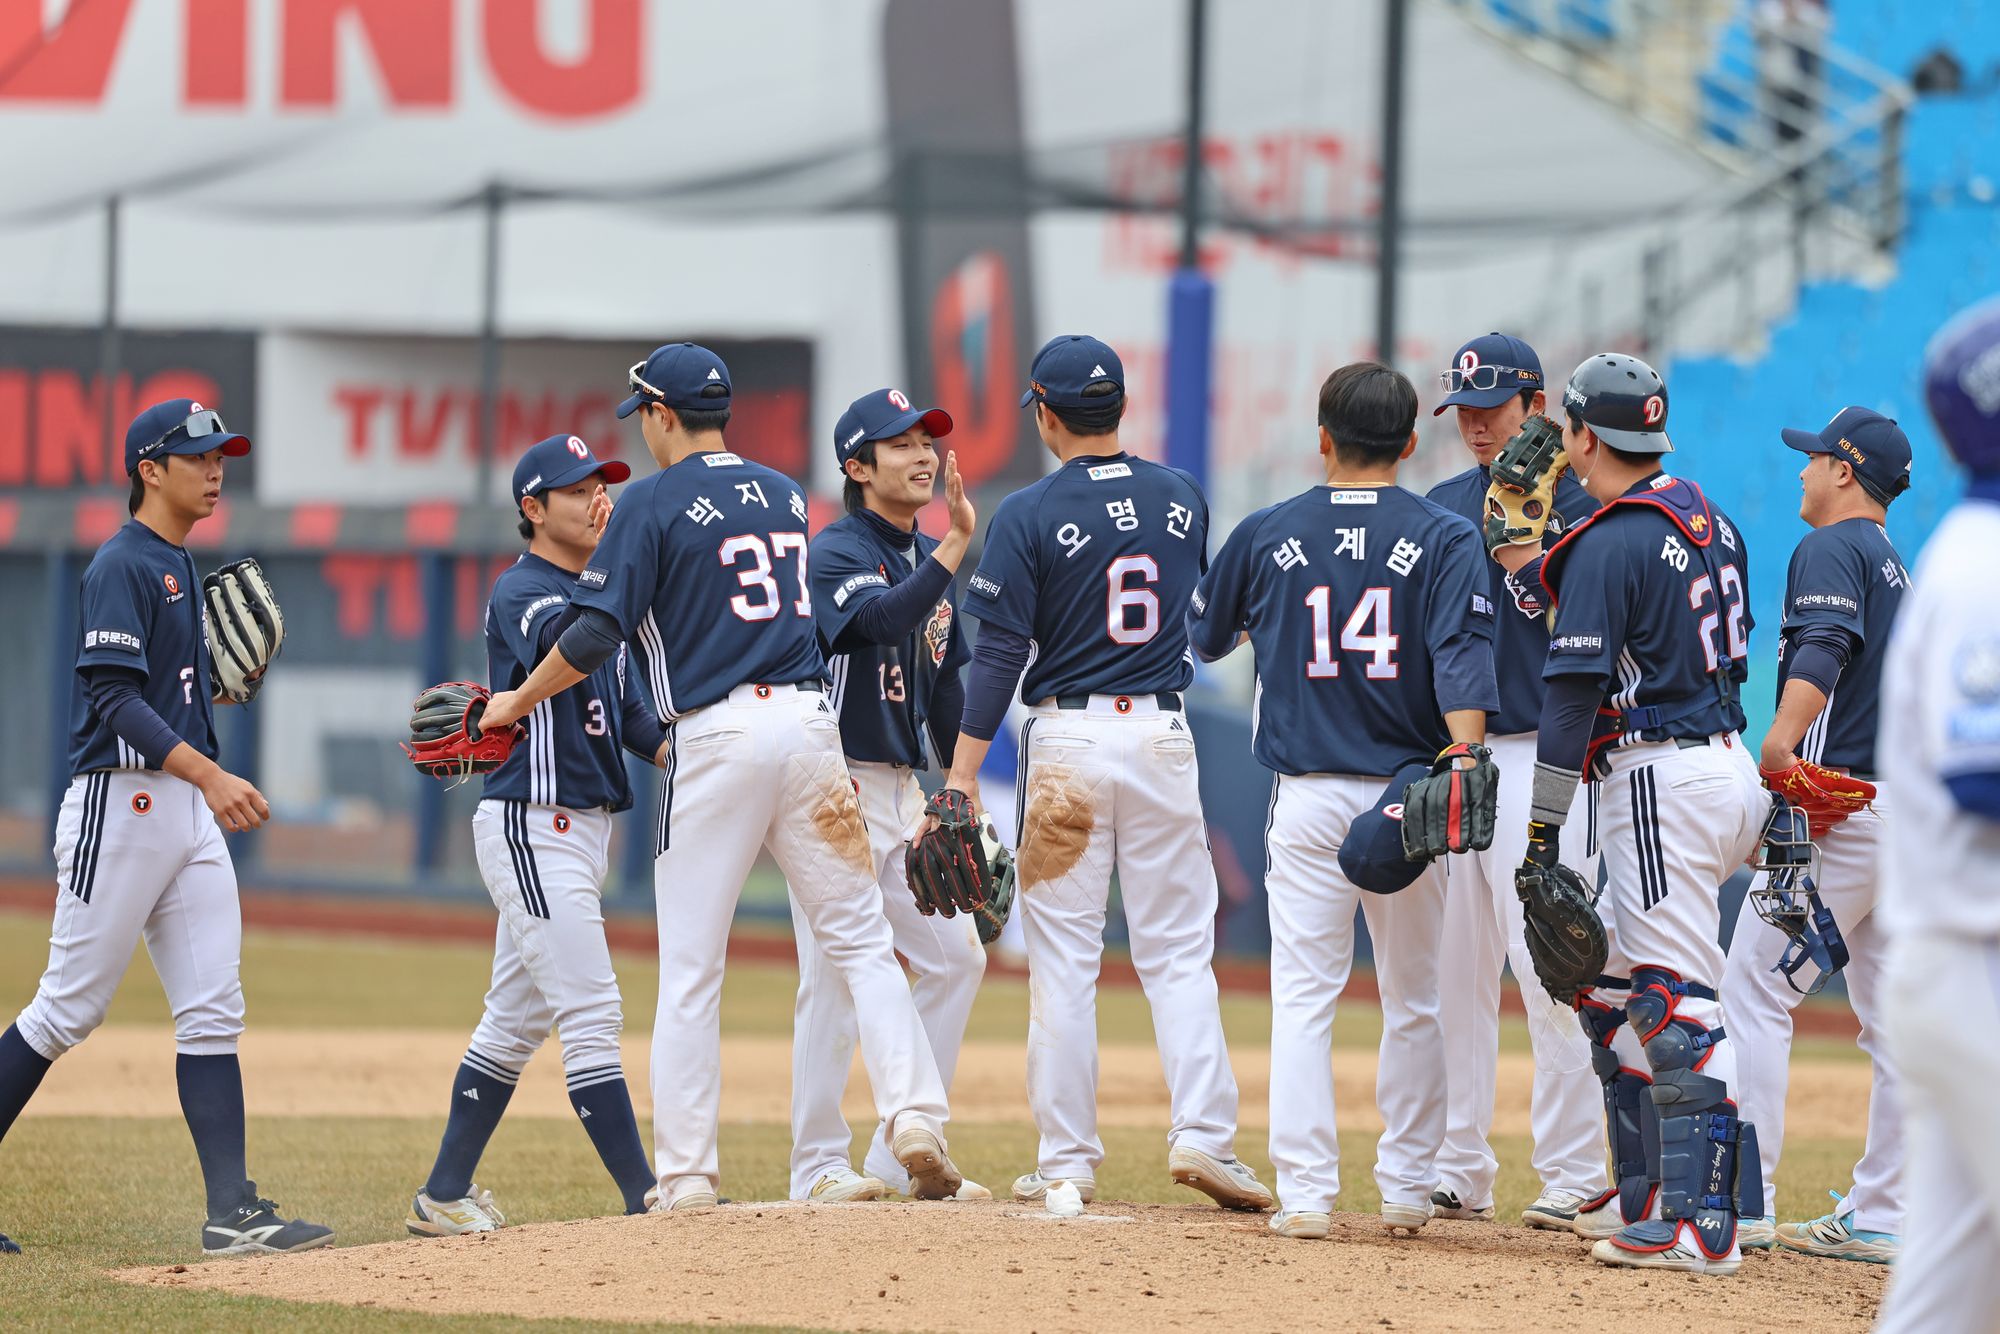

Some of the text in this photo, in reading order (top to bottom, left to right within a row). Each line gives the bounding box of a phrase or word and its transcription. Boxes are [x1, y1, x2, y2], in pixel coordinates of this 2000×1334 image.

[1838, 437, 1866, 465] KB Pay
[717, 532, 812, 623] 37
[1107, 553, 1161, 646] 6
[1687, 563, 1748, 673] 22
[98, 631, 140, 649] 동문건설
[1304, 585, 1399, 681] 14
[879, 663, 906, 703] 13
